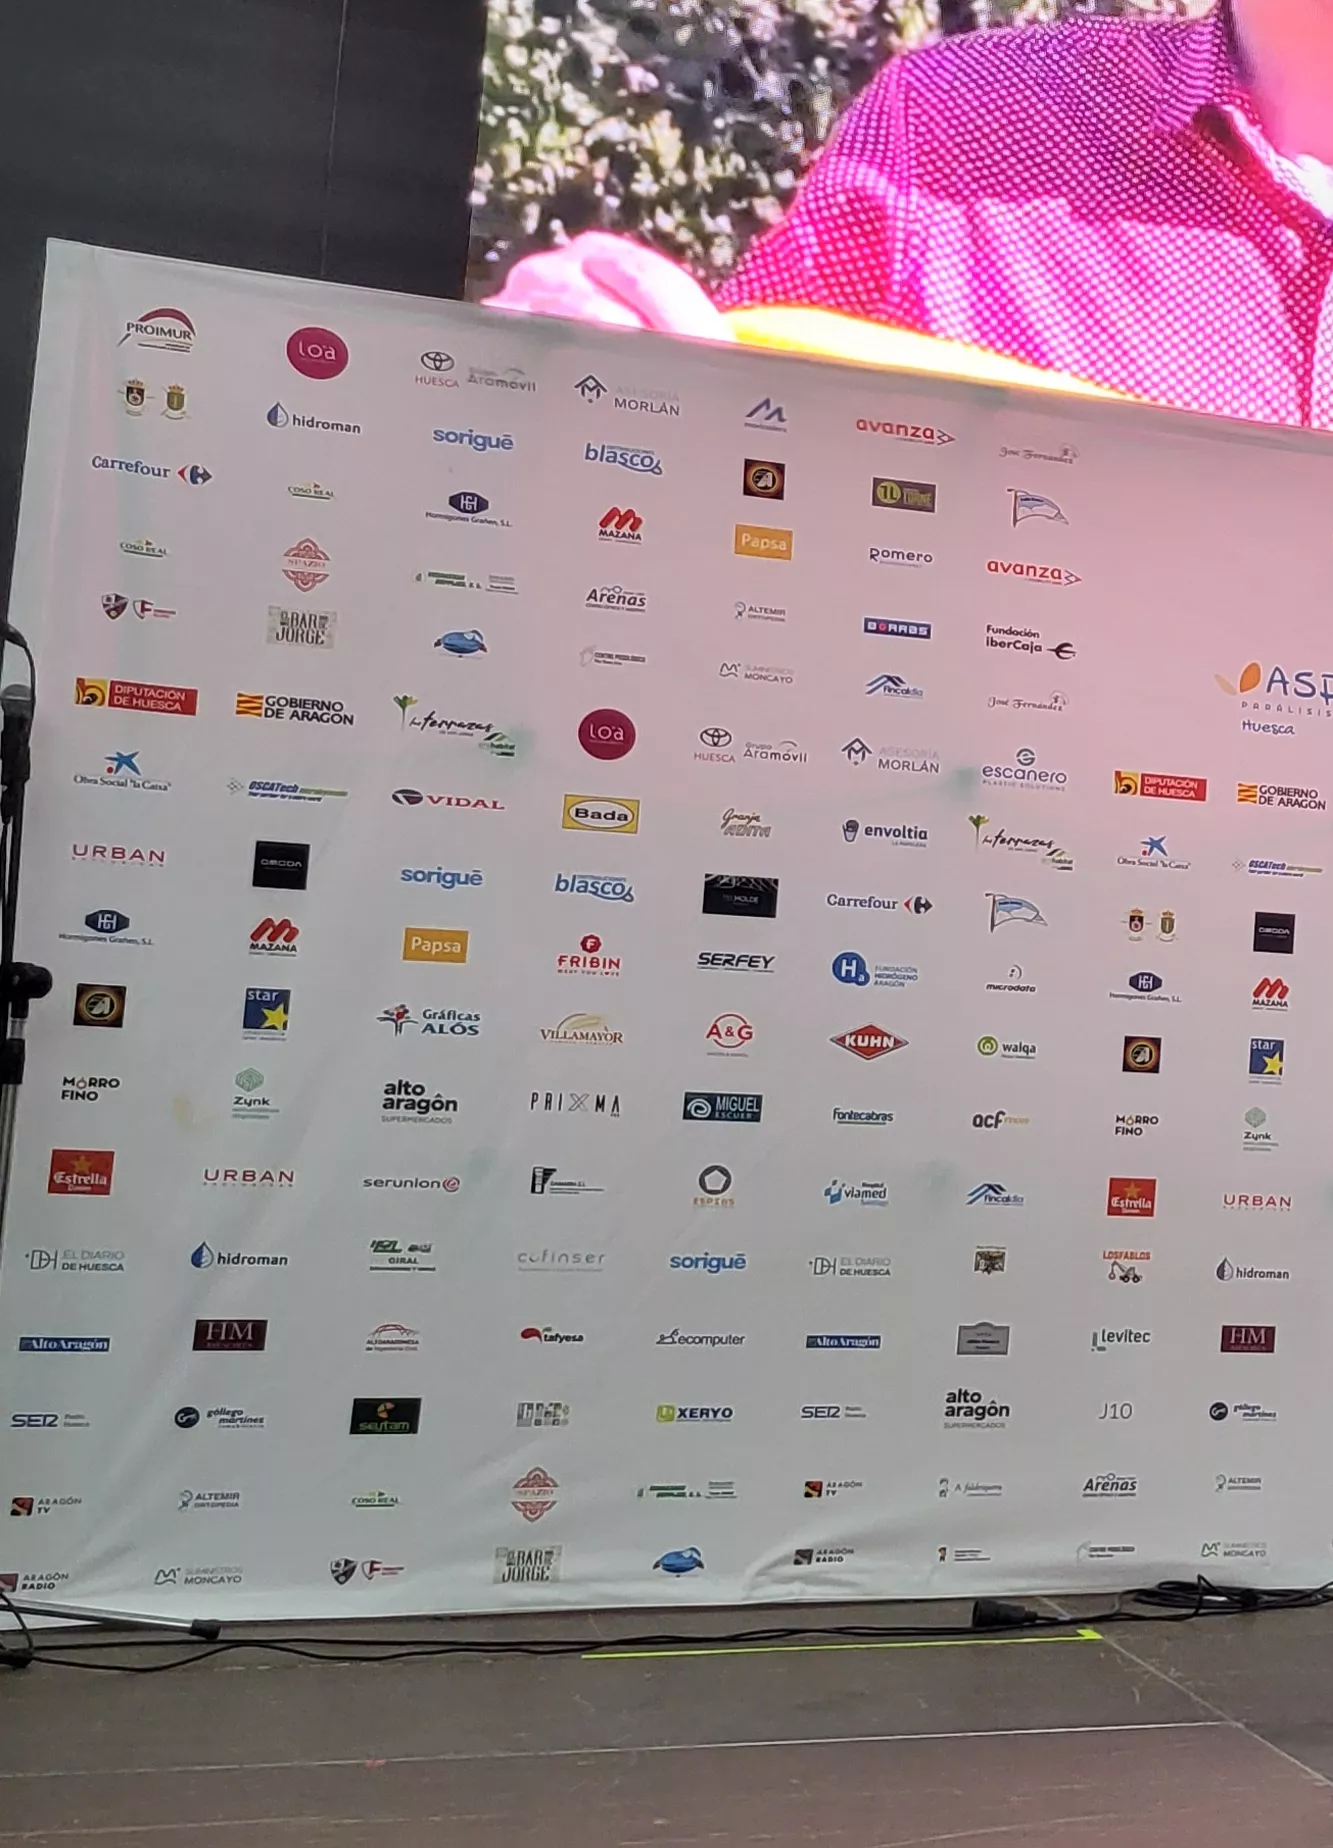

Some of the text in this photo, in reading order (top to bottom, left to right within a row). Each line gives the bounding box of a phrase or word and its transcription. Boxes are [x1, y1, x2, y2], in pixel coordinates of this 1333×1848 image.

[126, 321, 192, 341] PROIMUR
[415, 376, 459, 388] HUESCA
[614, 397, 680, 416] MORLÁN
[292, 413, 361, 434] hidroman
[857, 418, 934, 440] avanza
[585, 443, 656, 471] blasco
[92, 455, 171, 479] Carrefour
[599, 529, 641, 541] MAZANA
[741, 533, 787, 551] Papsa
[870, 547, 933, 563] Romero
[987, 560, 1062, 580] avanza
[586, 588, 647, 607] Arenas
[749, 606, 786, 616] ALTEMIR
[288, 611, 318, 629] BAR
[276, 628, 325, 645] JORGE
[987, 625, 1040, 639] Fundación
[745, 673, 793, 684] MONCAYO
[115, 685, 185, 700] DIPUTACIÓN
[114, 696, 182, 711] DE HUESCA
[265, 697, 344, 711] GOBIERNO
[264, 708, 283, 719] DE
[1242, 720, 1295, 735] Huesca
[694, 753, 735, 763] HUESCA
[878, 758, 939, 773] MORLÁN
[982, 764, 1067, 784] escanero
[1144, 776, 1197, 789] DIPUTACIÓN
[1144, 786, 1195, 798] DE HUESCA
[1259, 785, 1318, 799] GOBIERNO
[427, 794, 504, 810] VIDAL
[1259, 796, 1273, 806] DE
[575, 808, 629, 822] Bada
[865, 824, 928, 841] envoltia
[72, 844, 165, 863] URBAN
[555, 874, 626, 898] blasco
[827, 894, 898, 910] Carrefour
[250, 942, 297, 953] MAZANA
[411, 936, 461, 954] Papsa
[558, 955, 620, 970] FRIBIN
[697, 953, 776, 969] SERFEY
[986, 983, 1036, 993] microdata
[247, 990, 278, 1001] star
[1253, 999, 1288, 1008] MAZANA
[422, 1008, 481, 1022] Gráficas
[422, 1021, 479, 1037] ALÓS
[541, 1026, 623, 1044] VILLAMAYOR
[845, 1035, 894, 1048] KUHN
[1002, 1041, 1036, 1056] walqa
[1252, 1039, 1275, 1050] star
[384, 1079, 425, 1096] alto
[61, 1090, 98, 1102] FINO
[233, 1096, 270, 1107] Zynk
[382, 1094, 457, 1115] aragón
[716, 1096, 759, 1113] MIGUEL
[973, 1111, 1006, 1129] acf
[1115, 1127, 1143, 1136] FINO
[1244, 1132, 1271, 1141] Zynk
[54, 1172, 108, 1186] Estrella
[204, 1169, 294, 1183] URBAN
[363, 1177, 440, 1190] serunion
[845, 1185, 887, 1200] viamed
[1111, 1196, 1152, 1210] Estrella
[1224, 1194, 1291, 1207] URBAN
[64, 1251, 124, 1261] EL DIARIO
[217, 1253, 288, 1266] hidroman
[840, 1257, 891, 1266] EL DIARIO
[62, 1262, 124, 1272] DE HUESCA
[840, 1268, 891, 1276] DE HUESCA
[1236, 1266, 1289, 1280] hidroman
[206, 1322, 253, 1341] HM
[544, 1332, 583, 1343] tafyesa
[1101, 1329, 1150, 1346] levitec
[1230, 1328, 1266, 1344] HM
[678, 1333, 745, 1347] ecomputer
[946, 1388, 982, 1404] alto
[677, 1407, 733, 1419] XERYO
[944, 1401, 1010, 1419] aragón
[1099, 1403, 1132, 1420] J10
[1083, 1477, 1137, 1493] Arenas
[195, 1492, 239, 1500] ALTEMIR
[37, 1506, 50, 1514] TV
[185, 1574, 241, 1585] MONCAYO
[502, 1568, 550, 1582] JORGE
[22, 1582, 55, 1590] RADIO
